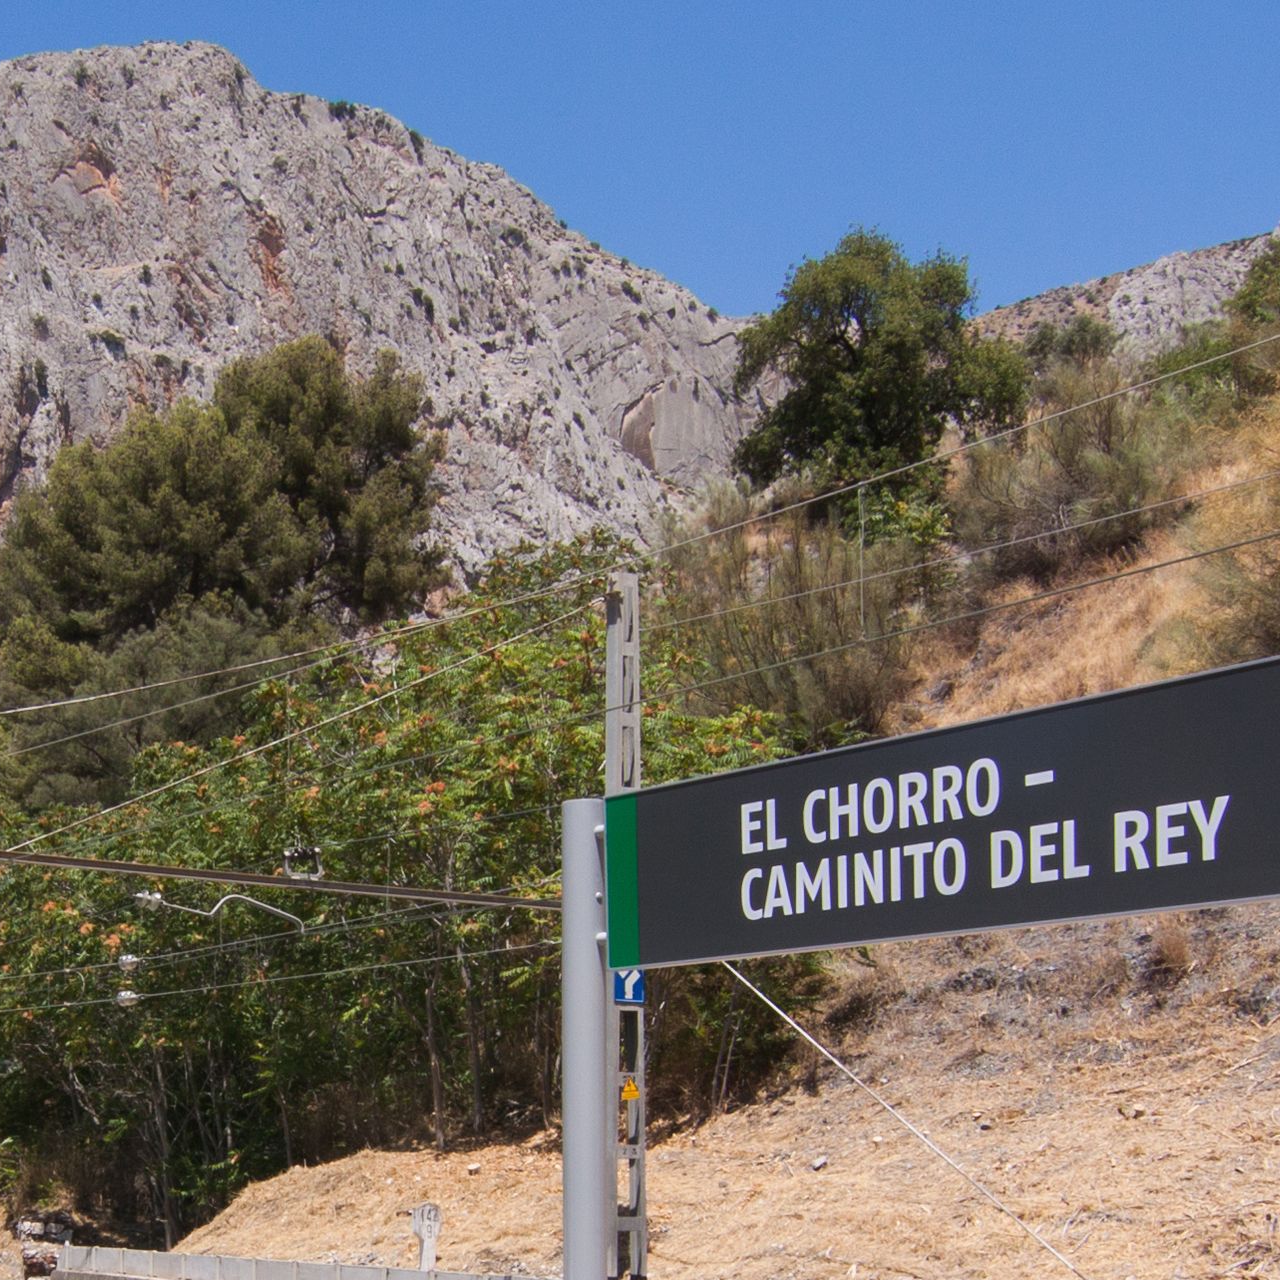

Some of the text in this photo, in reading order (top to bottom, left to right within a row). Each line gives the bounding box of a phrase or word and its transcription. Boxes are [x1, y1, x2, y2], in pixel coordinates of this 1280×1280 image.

[741, 798, 787, 854] EL
[803, 757, 1000, 844] CHORRO
[741, 795, 1230, 921] CAMINITO DEL REY
